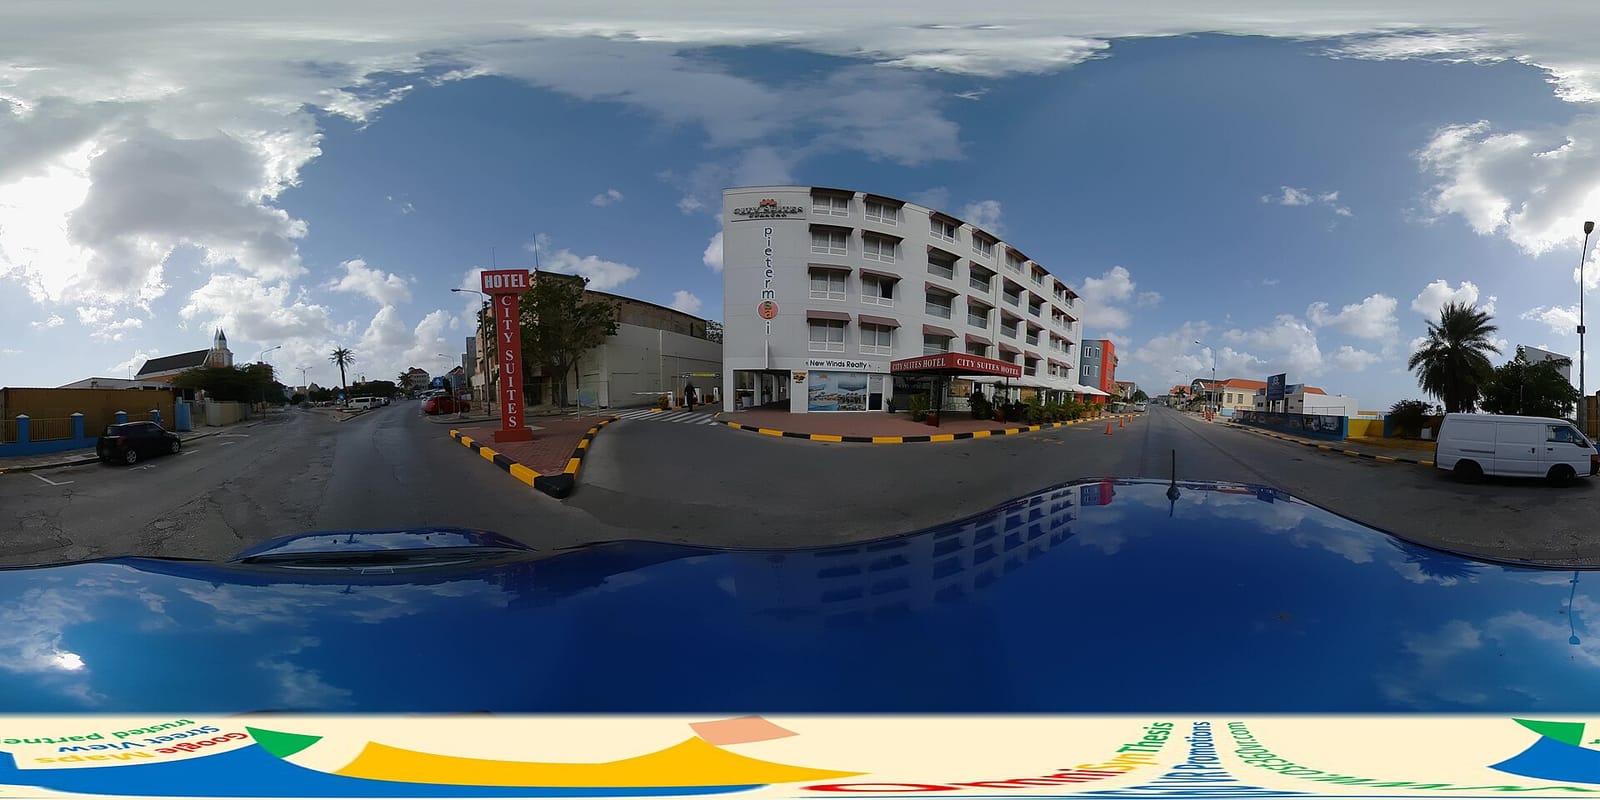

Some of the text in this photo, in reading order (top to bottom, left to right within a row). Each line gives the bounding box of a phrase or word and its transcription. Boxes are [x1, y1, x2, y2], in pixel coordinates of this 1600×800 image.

[484, 273, 527, 288] HOTEL
[501, 295, 517, 428] CITY SUITES
[825, 360, 845, 368] Winds
[846, 361, 867, 369] Realty
[893, 358, 946, 371] CITY SUITES HOTEL
[957, 358, 1019, 375] CITY SUITES HOTEL
